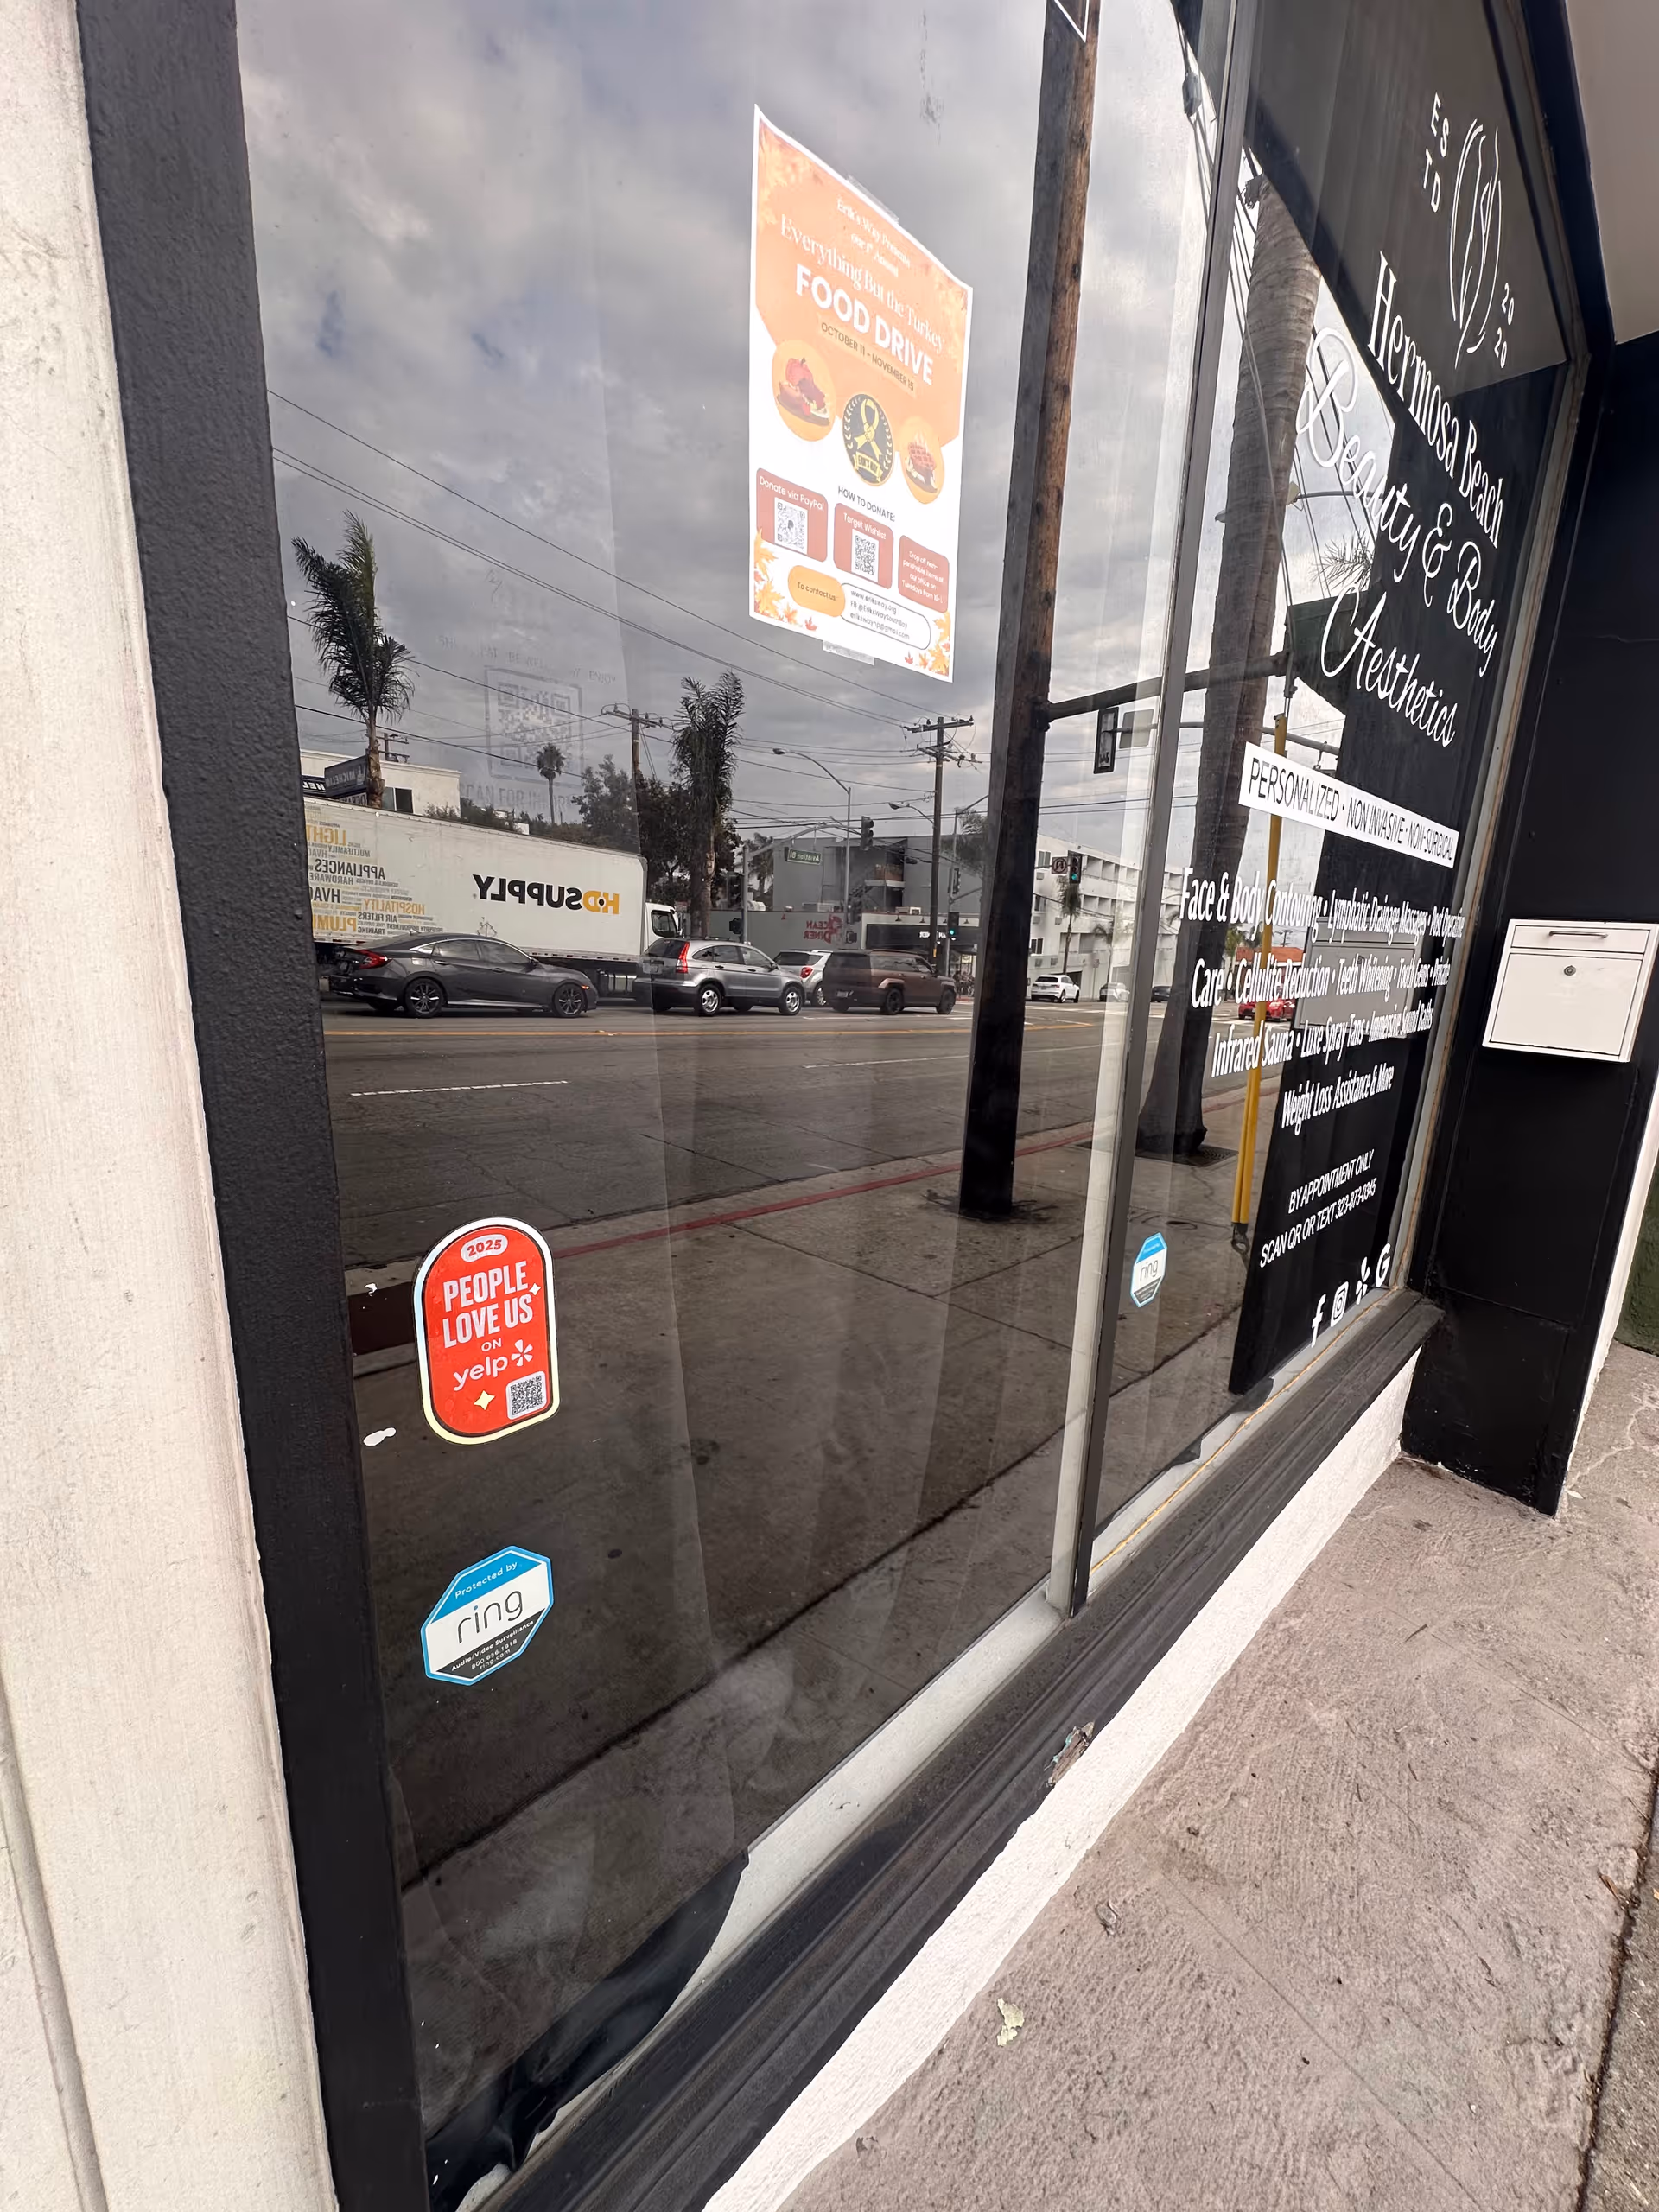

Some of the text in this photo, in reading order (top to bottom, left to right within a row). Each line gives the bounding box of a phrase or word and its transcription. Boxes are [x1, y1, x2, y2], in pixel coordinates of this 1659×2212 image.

[781, 213, 945, 354] Everything But the Turkey
[796, 263, 934, 385] FOOD DRIVE
[821, 322, 858, 351] OCTOBER
[860, 344, 866, 356] 11
[872, 353, 907, 385] NOVEMBER
[908, 380, 914, 391] 15
[1368, 251, 1503, 548] Hermosa Beach
[760, 476, 825, 512] Donate via PayPal
[838, 486, 895, 522] HOW TO DONATE:
[1296, 327, 1498, 677] Beauty & Body
[843, 512, 887, 540] Target Wishlist
[909, 551, 919, 563] Drop
[917, 577, 930, 588] office
[805, 585, 829, 600] contact
[902, 580, 922, 594] Tuesdays
[923, 589, 933, 600] from
[1321, 583, 1458, 747] Aesthetics
[1249, 757, 1452, 861] PERSONALIZED NON INVASIVE NON-SURGICAL
[1179, 867, 1465, 947] Face & Body Contouring Lymphatic Drainage Massages Post Operative
[1192, 958, 1224, 1008] Care
[1235, 952, 1282, 1004] Cellulite
[1281, 952, 1330, 1000] Reduction
[1336, 953, 1359, 995] Teeth
[1358, 953, 1394, 1003] Whitening
[1396, 953, 1416, 989] Tooth
[1414, 958, 1431, 988] Gems
[1211, 999, 1433, 1077] Infrared Sauna Luxe Spray Tans Immersive Sound Baths
[1281, 1062, 1395, 1136] Weight Loss Assistance & More
[1288, 1148, 1375, 1214] BY APPOINTMENT ONLY
[467, 1238, 502, 1257] 2025
[1260, 1231, 1287, 1268] SCAN
[1287, 1223, 1302, 1250] QR
[1302, 1215, 1316, 1240] OR
[1316, 1202, 1338, 1232] TEXT
[443, 1261, 528, 1312] PEOPLE
[1140, 1260, 1159, 1281] ring
[442, 1294, 533, 1348] LOVE US
[481, 1338, 502, 1352] ON
[453, 1356, 508, 1391] yelp
[454, 1561, 518, 1599] Protected by
[457, 1591, 523, 1643] ring
[451, 1620, 534, 1672] Audio/Video Surveillance
[480, 1649, 511, 1670] ring.com
